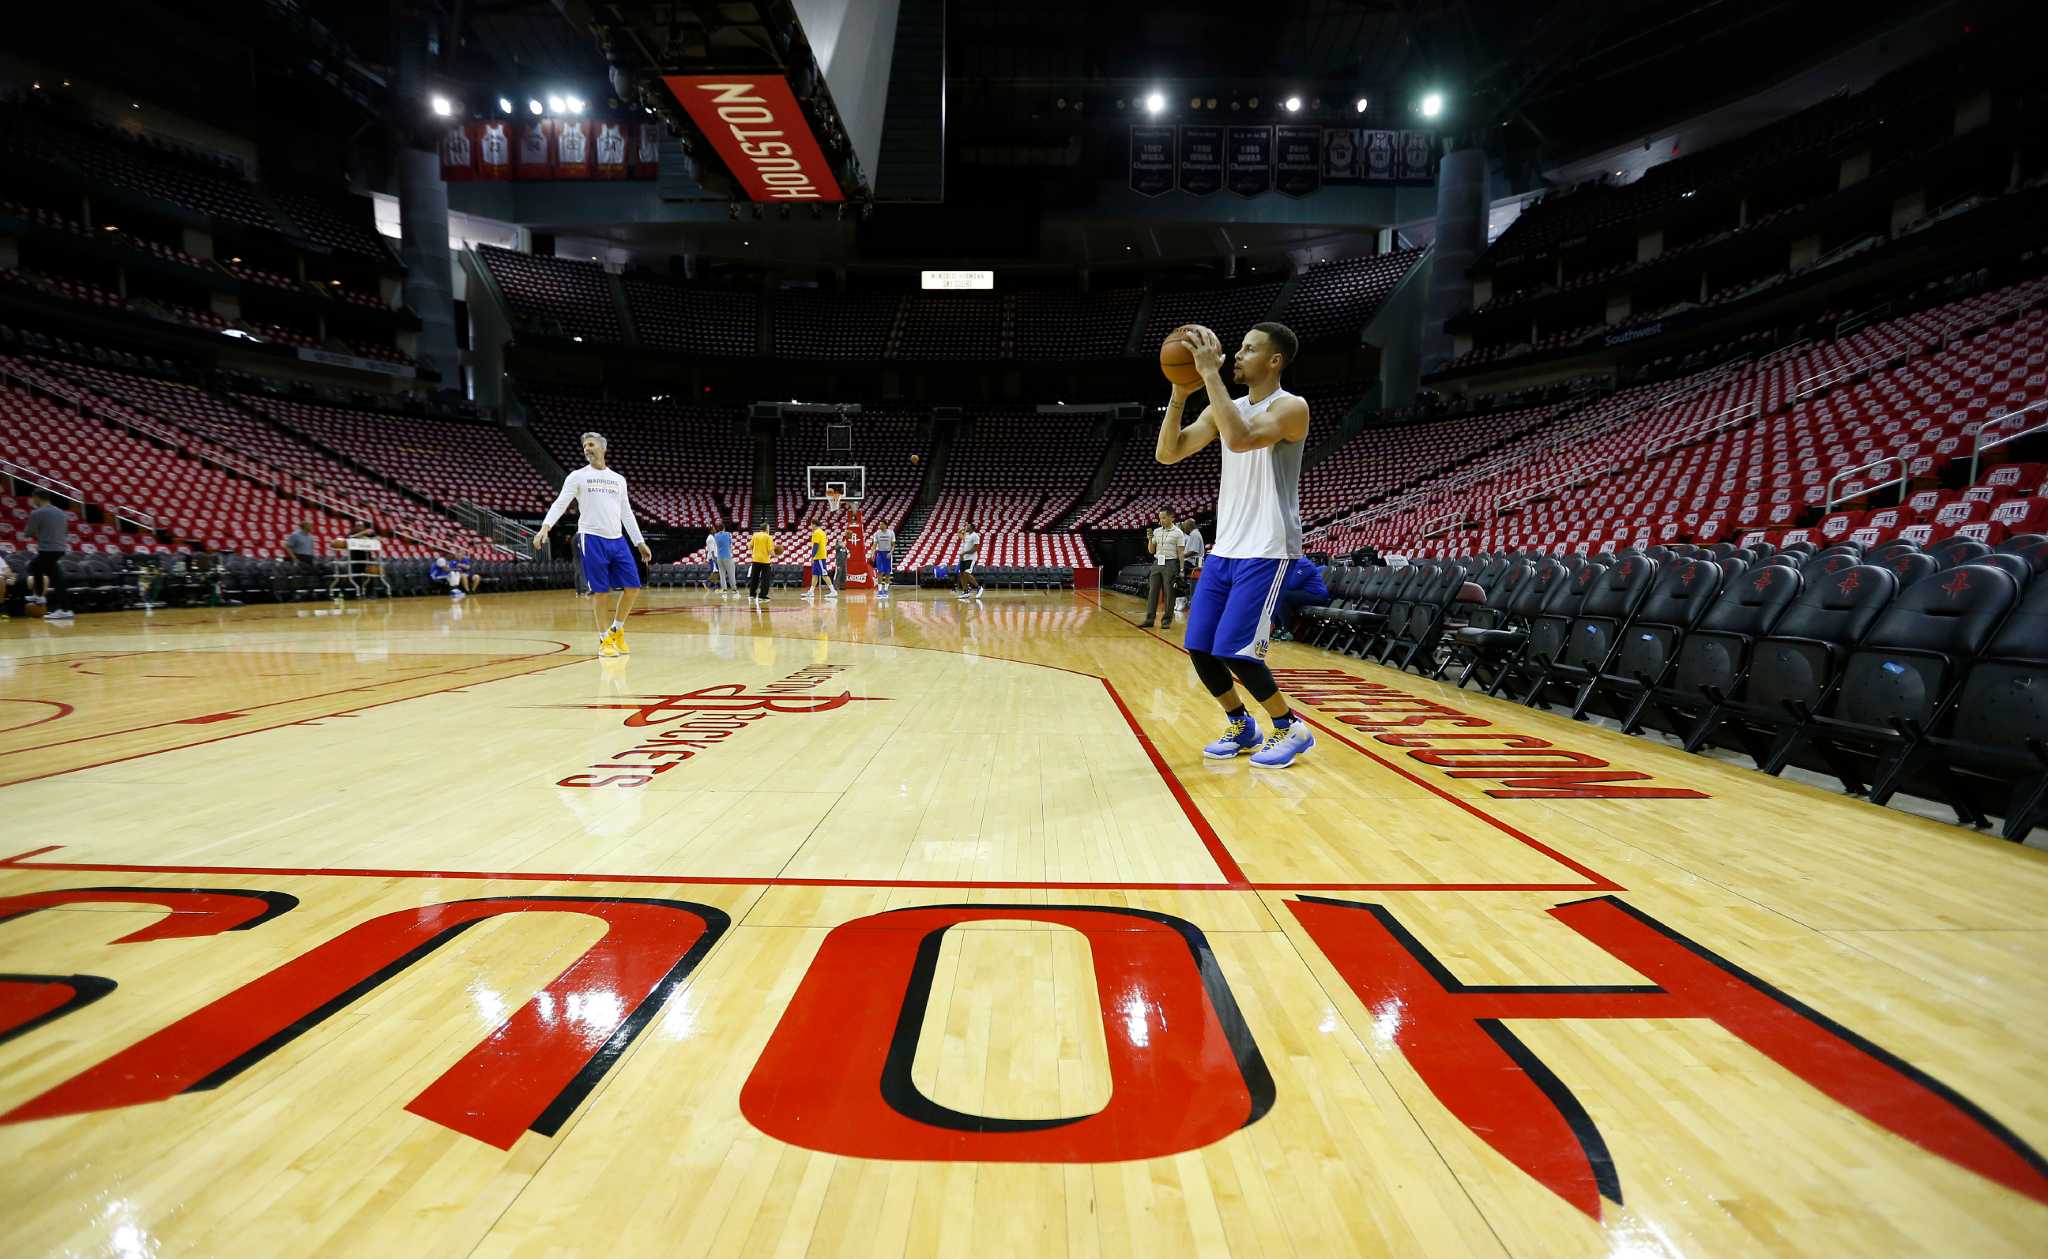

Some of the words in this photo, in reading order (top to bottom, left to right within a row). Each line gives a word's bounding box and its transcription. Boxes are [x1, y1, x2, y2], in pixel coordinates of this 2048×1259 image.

[696, 83, 823, 199] HOUSTON
[1605, 324, 1663, 346] Southwest
[755, 664, 857, 694] HOUSTON
[555, 711, 776, 788] ROCKETS
